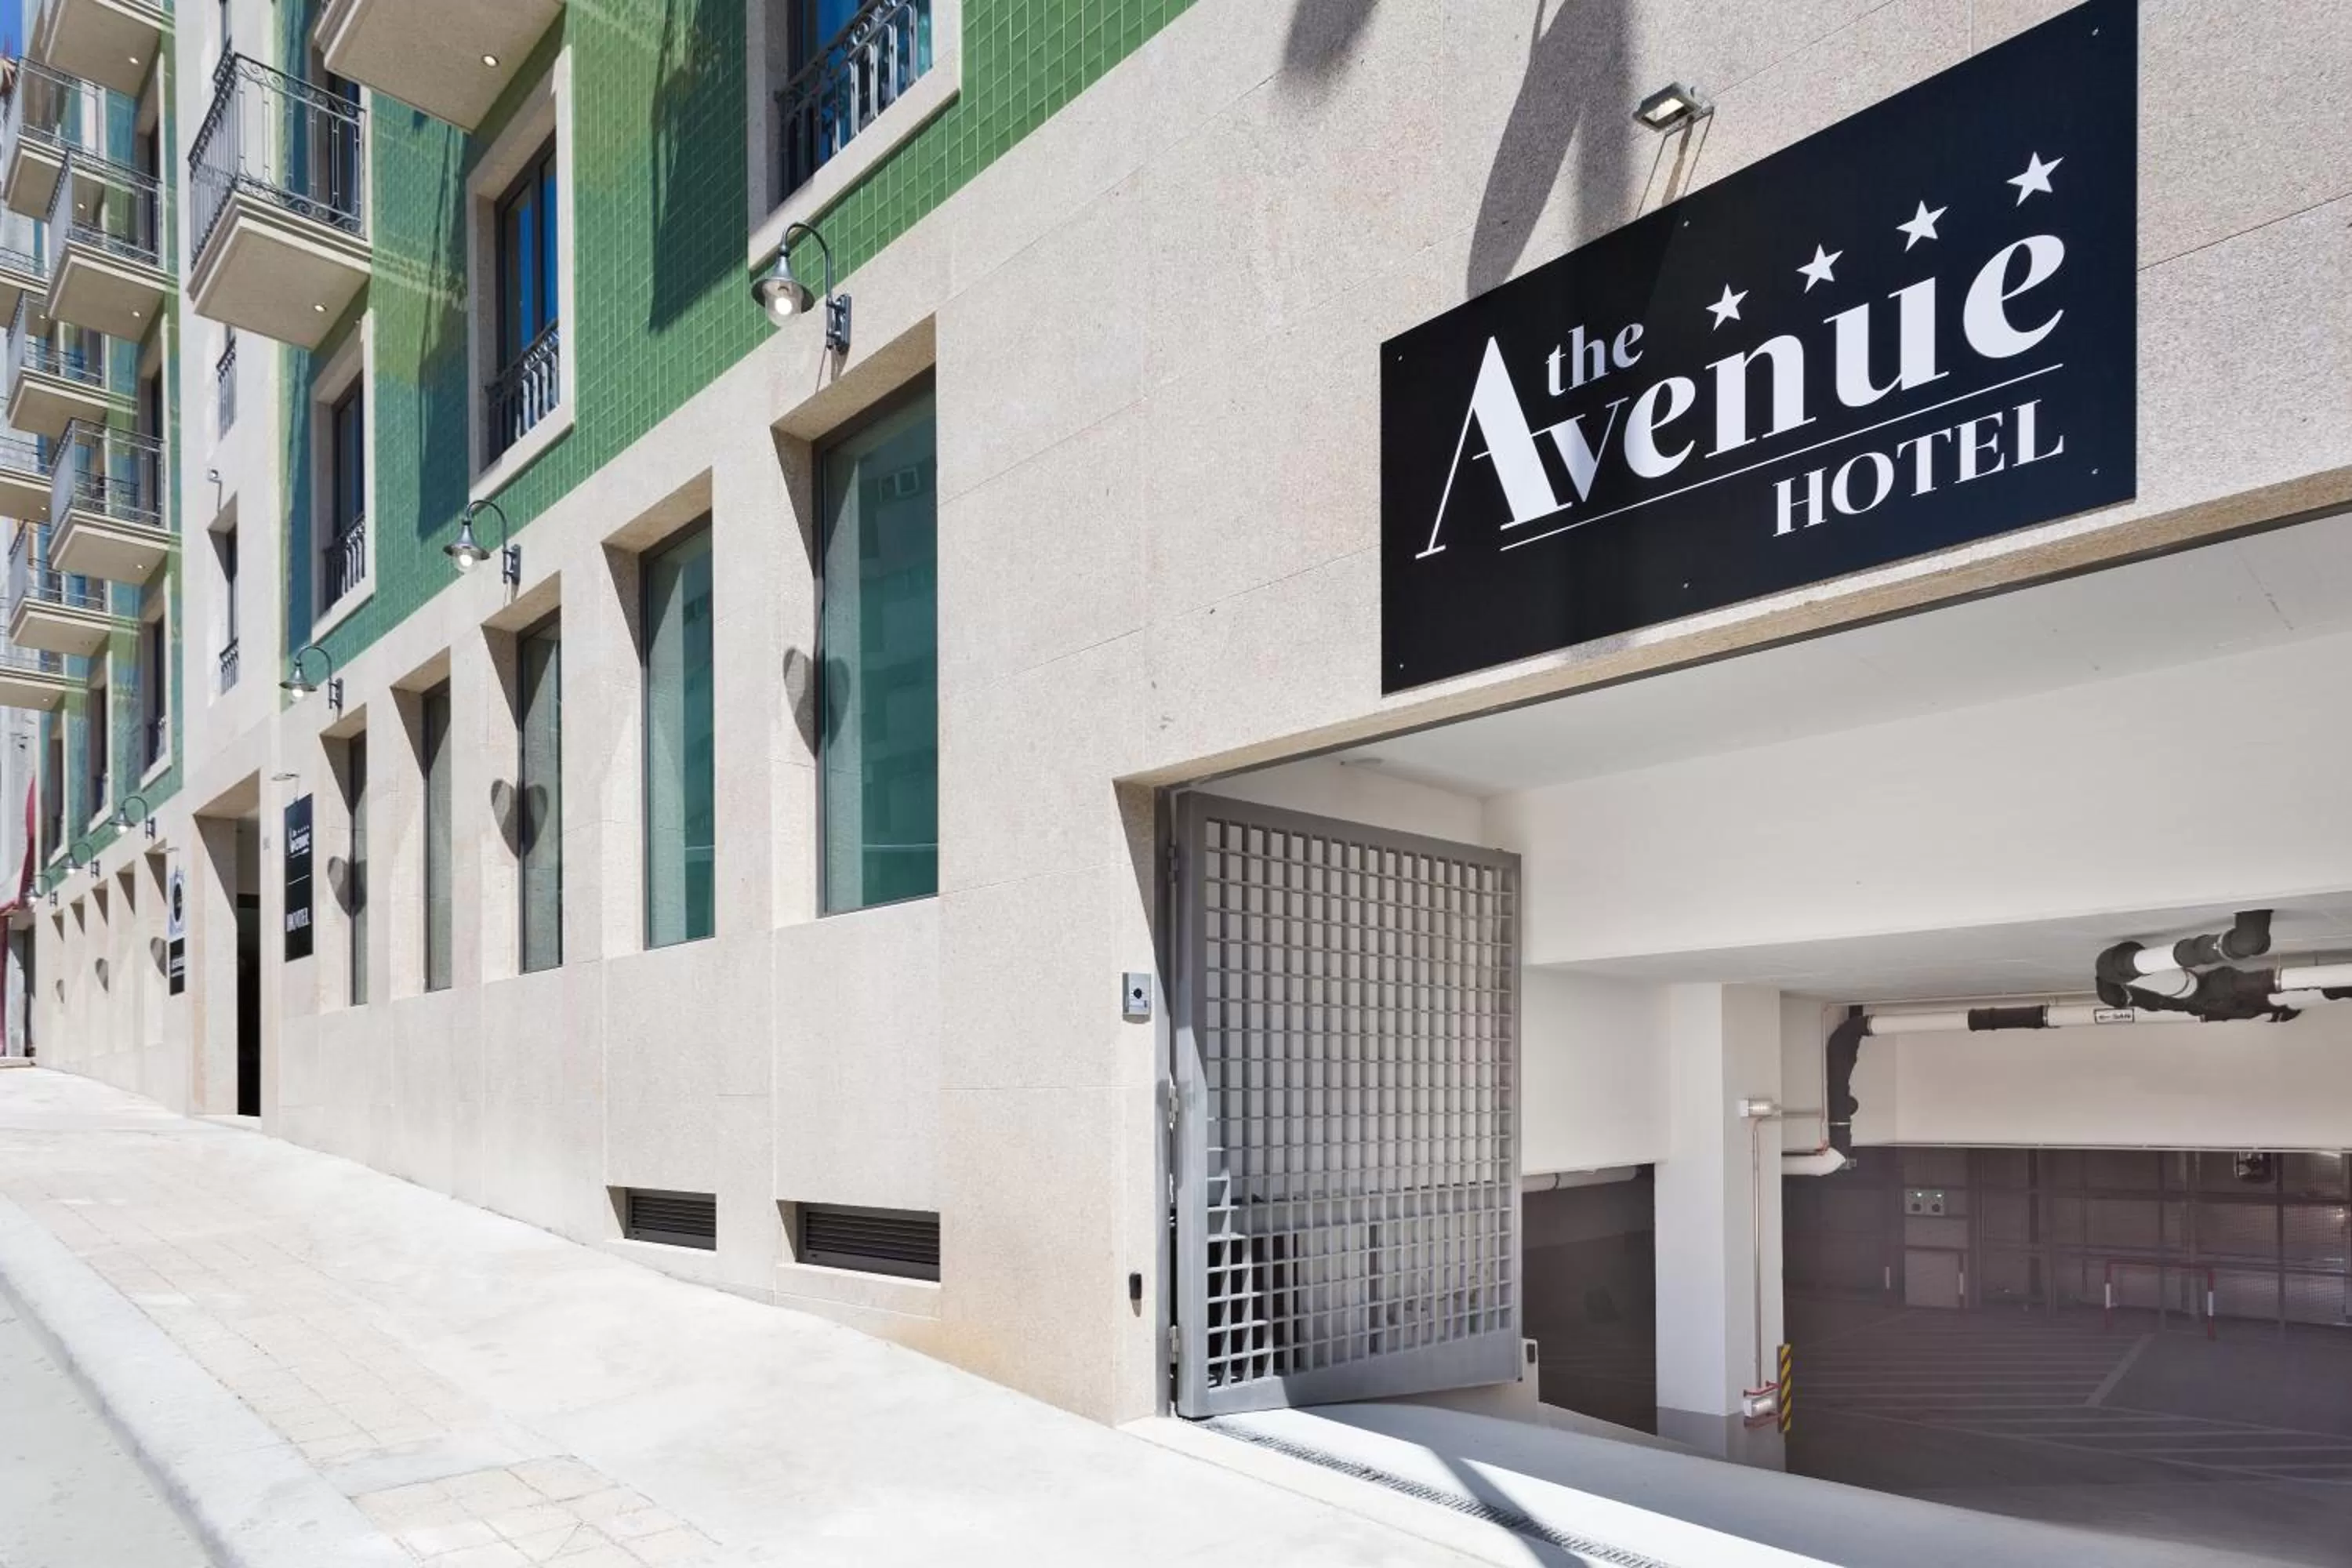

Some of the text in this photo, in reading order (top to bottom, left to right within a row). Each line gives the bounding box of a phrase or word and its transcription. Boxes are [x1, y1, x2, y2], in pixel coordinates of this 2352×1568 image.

[1414, 234, 2066, 560] Avenue
[1545, 323, 1644, 397] the
[1772, 399, 2064, 537] HOTEL
